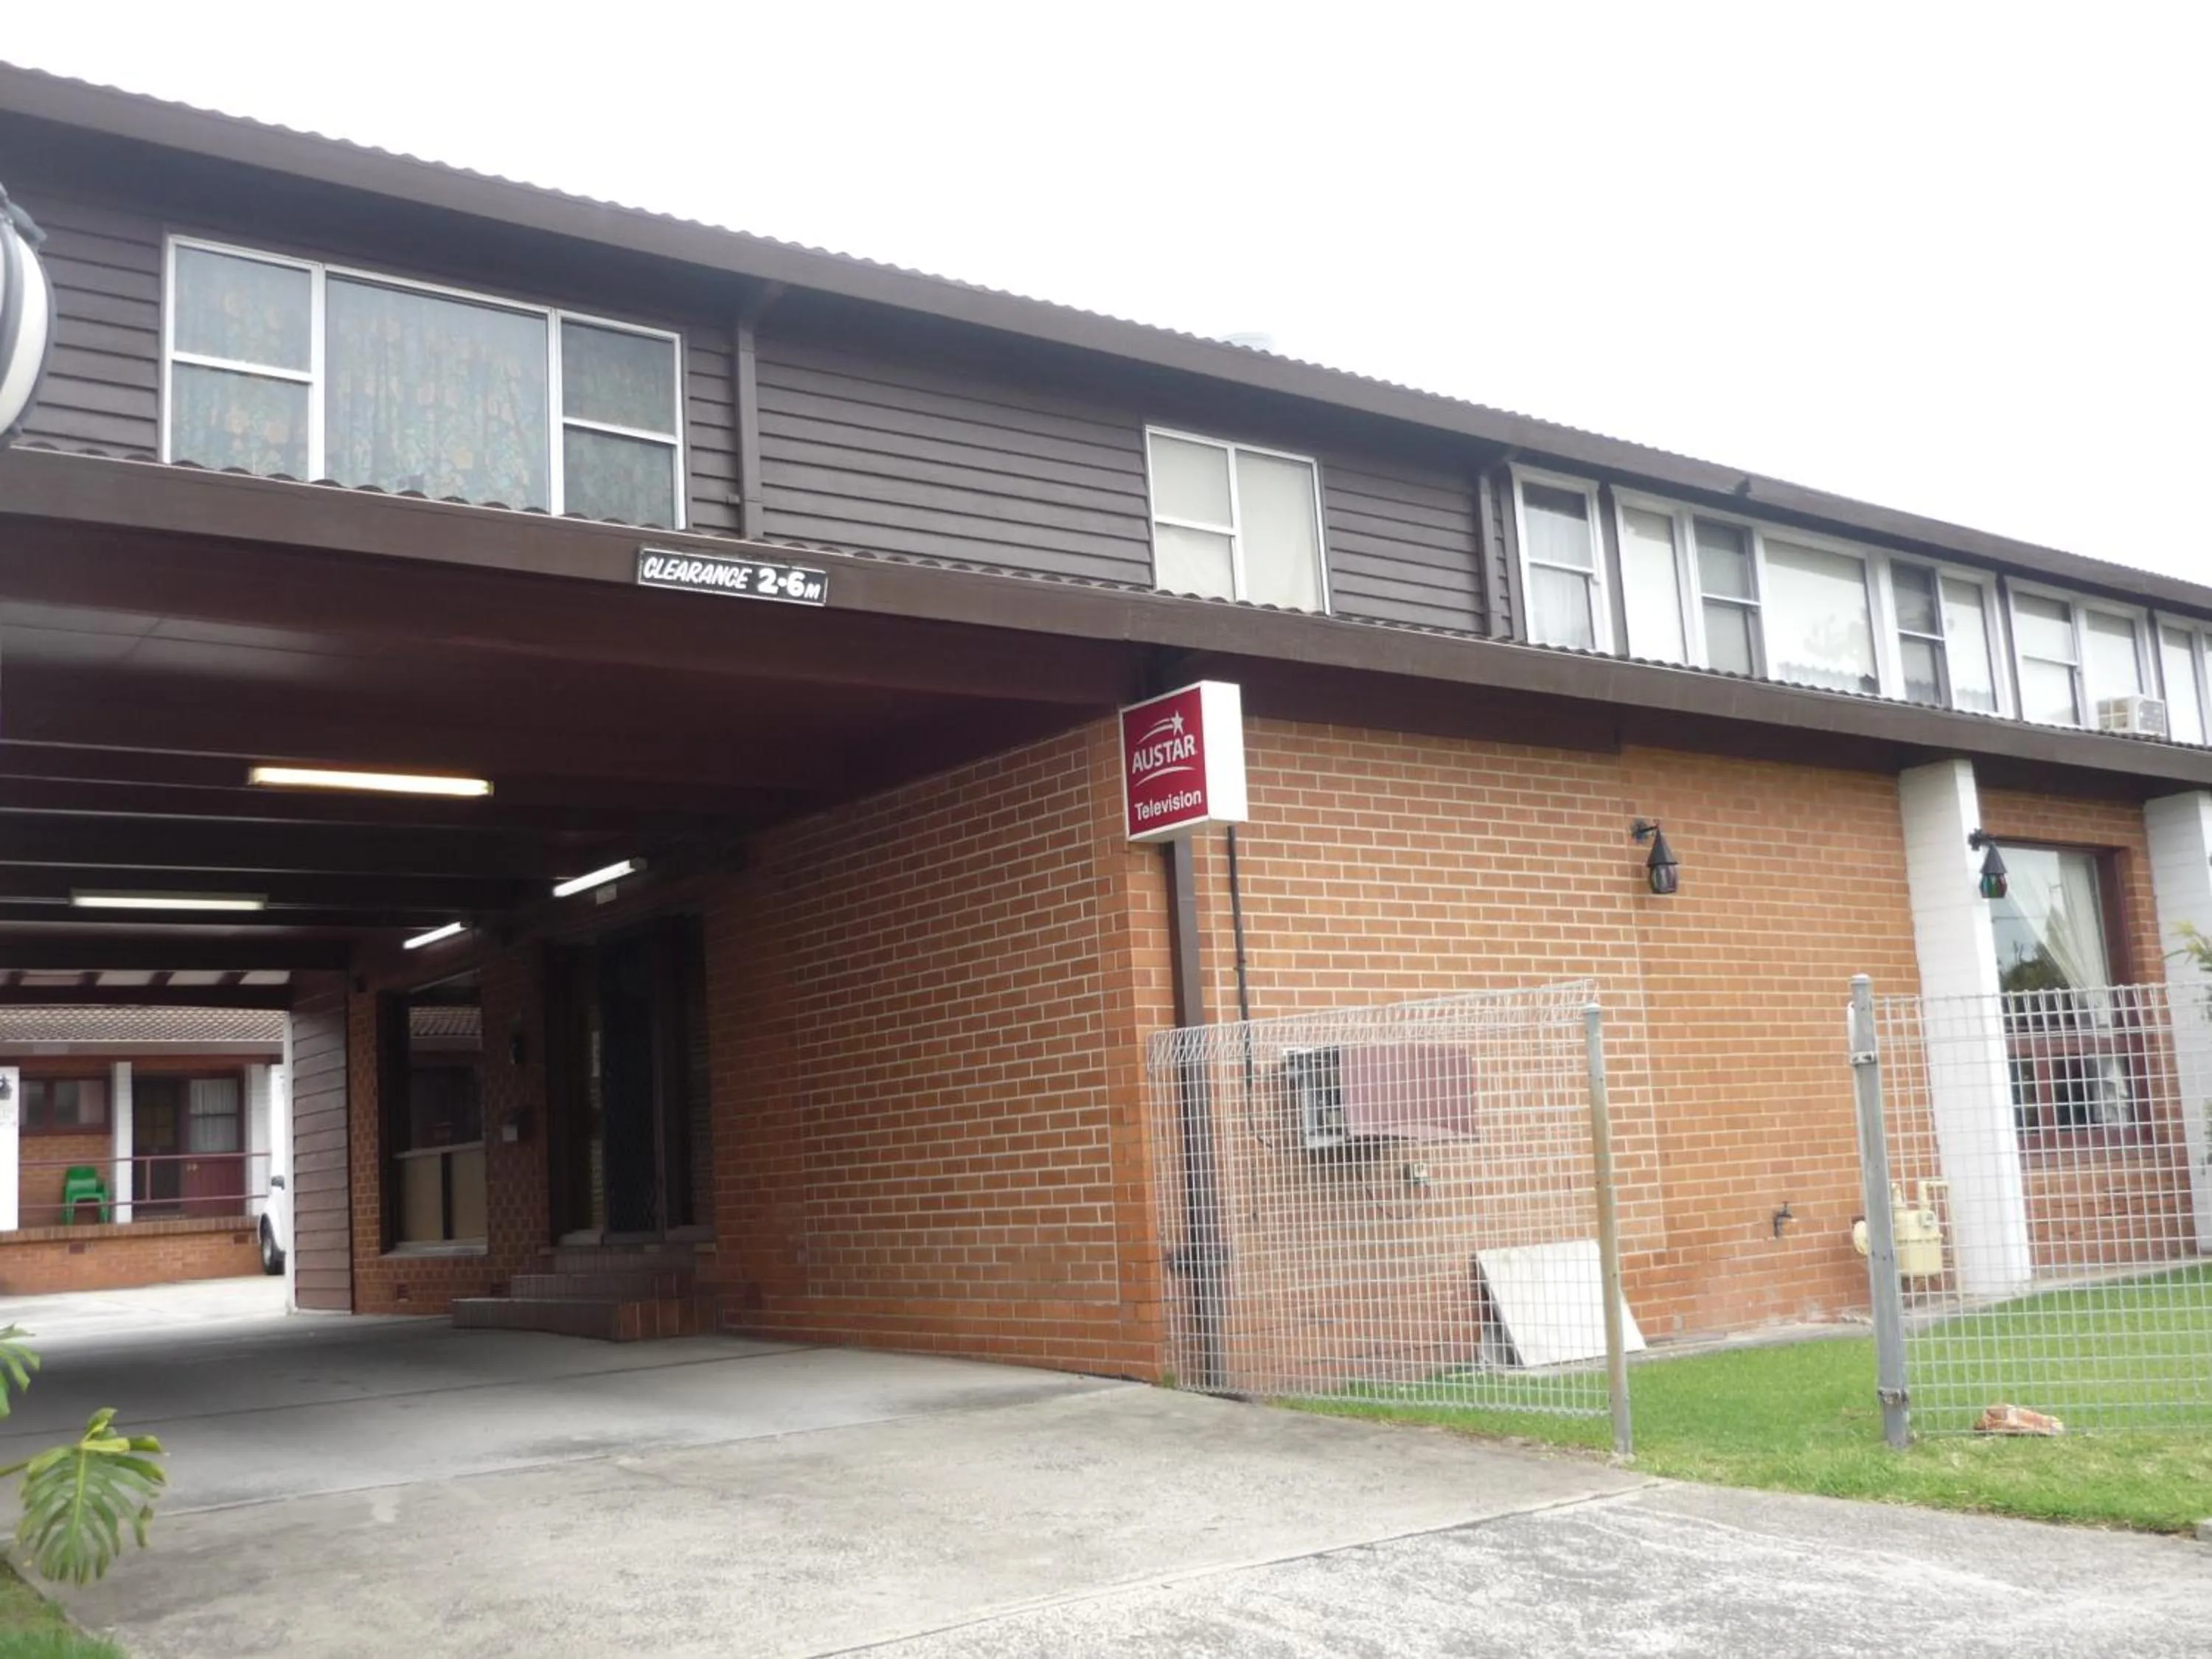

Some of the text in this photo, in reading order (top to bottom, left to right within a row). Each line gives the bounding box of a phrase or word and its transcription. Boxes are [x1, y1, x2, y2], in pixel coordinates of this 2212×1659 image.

[643, 556, 752, 589] CLEARANCE
[1132, 734, 1196, 774] AUSTAR
[1134, 790, 1203, 821] Television
